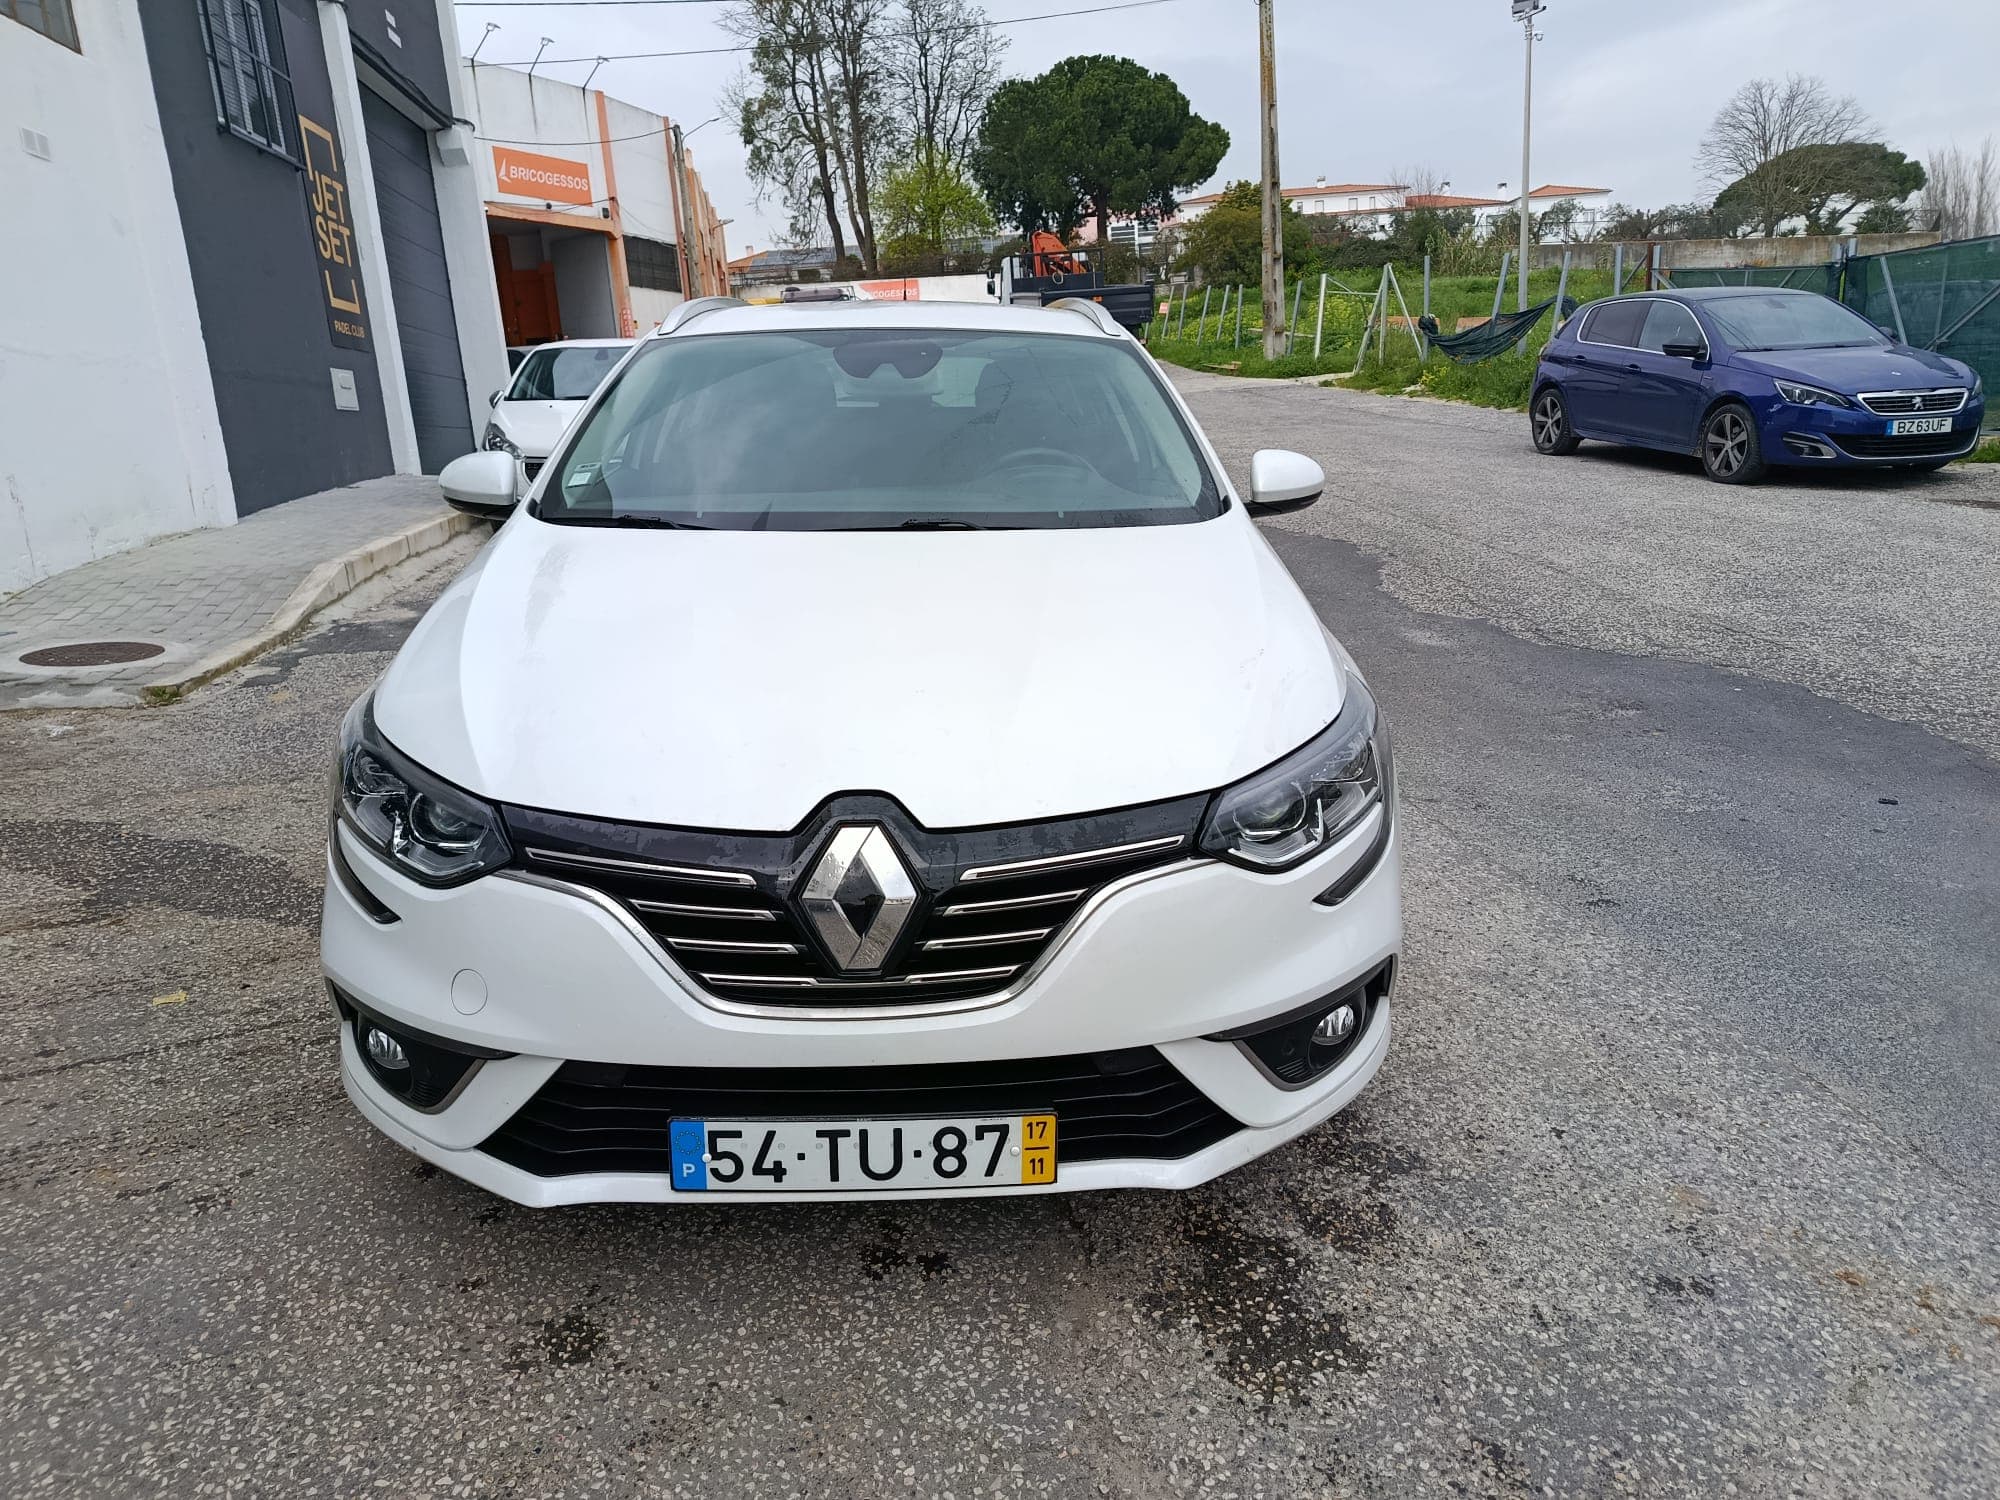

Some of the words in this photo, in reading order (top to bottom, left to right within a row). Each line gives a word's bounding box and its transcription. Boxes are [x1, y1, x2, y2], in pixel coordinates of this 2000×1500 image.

[509, 165, 589, 191] BRICOGESSOS
[312, 170, 344, 224] JET
[315, 214, 352, 268] SET
[334, 319, 352, 336] PADEL
[1026, 1121, 1048, 1139] 17
[682, 1163, 696, 1178] P
[1029, 1157, 1044, 1175] 11
